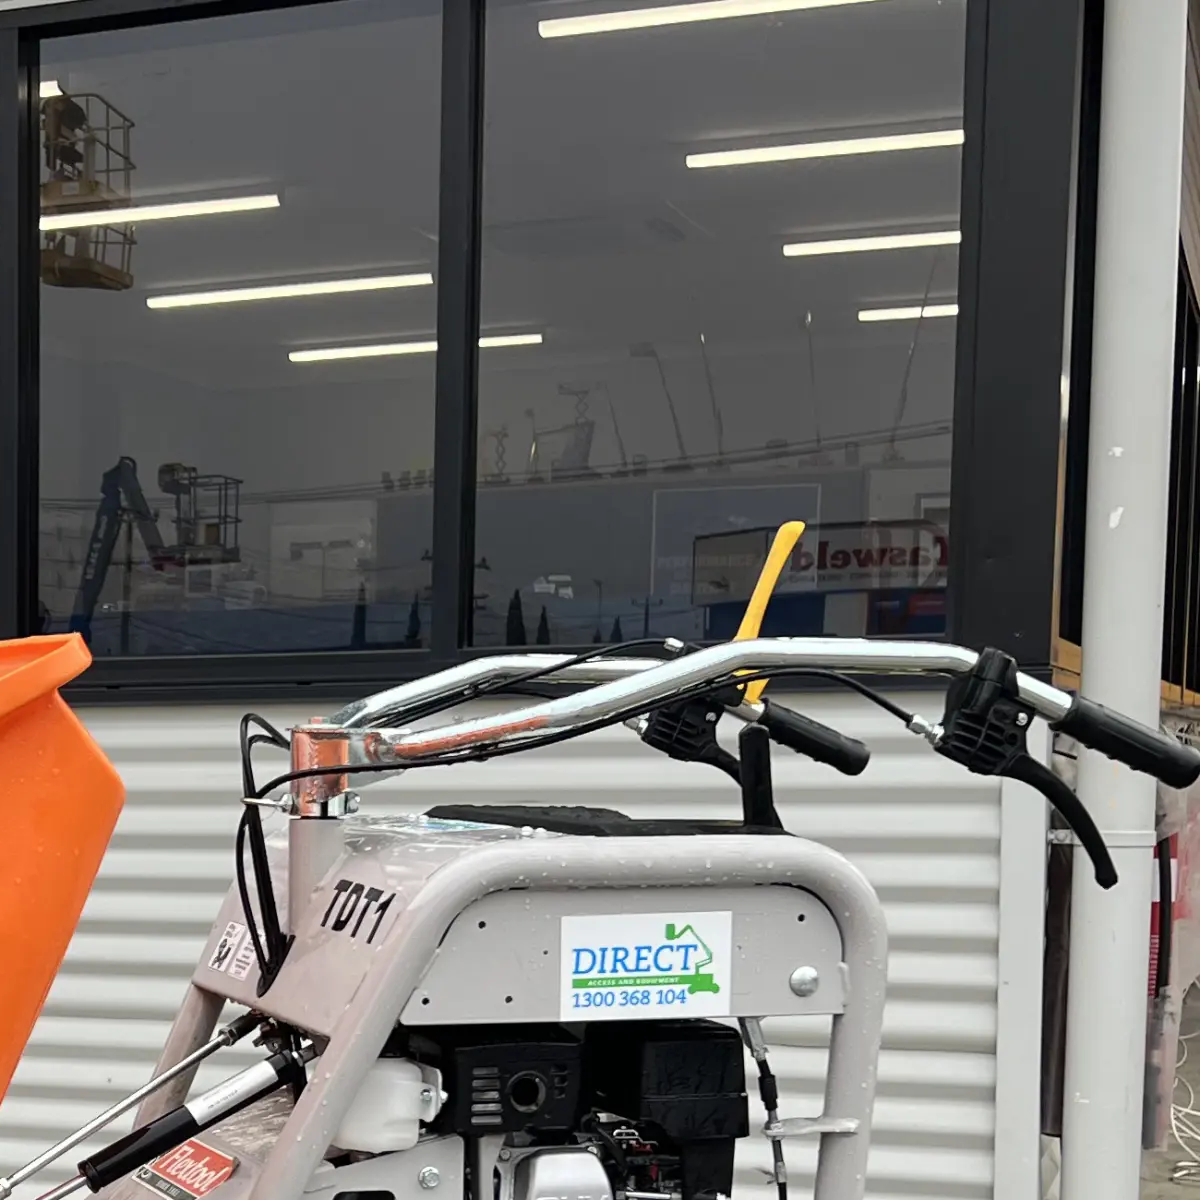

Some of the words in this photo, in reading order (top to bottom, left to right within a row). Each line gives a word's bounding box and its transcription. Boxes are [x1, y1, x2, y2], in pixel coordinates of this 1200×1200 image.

[320, 879, 397, 944] TDT1
[572, 943, 698, 975] DIRECT
[572, 991, 615, 1008] 1300
[619, 989, 650, 1006] 368
[656, 988, 687, 1005] 104
[587, 979, 616, 987] ACCESS
[158, 1144, 233, 1192] Flextool
